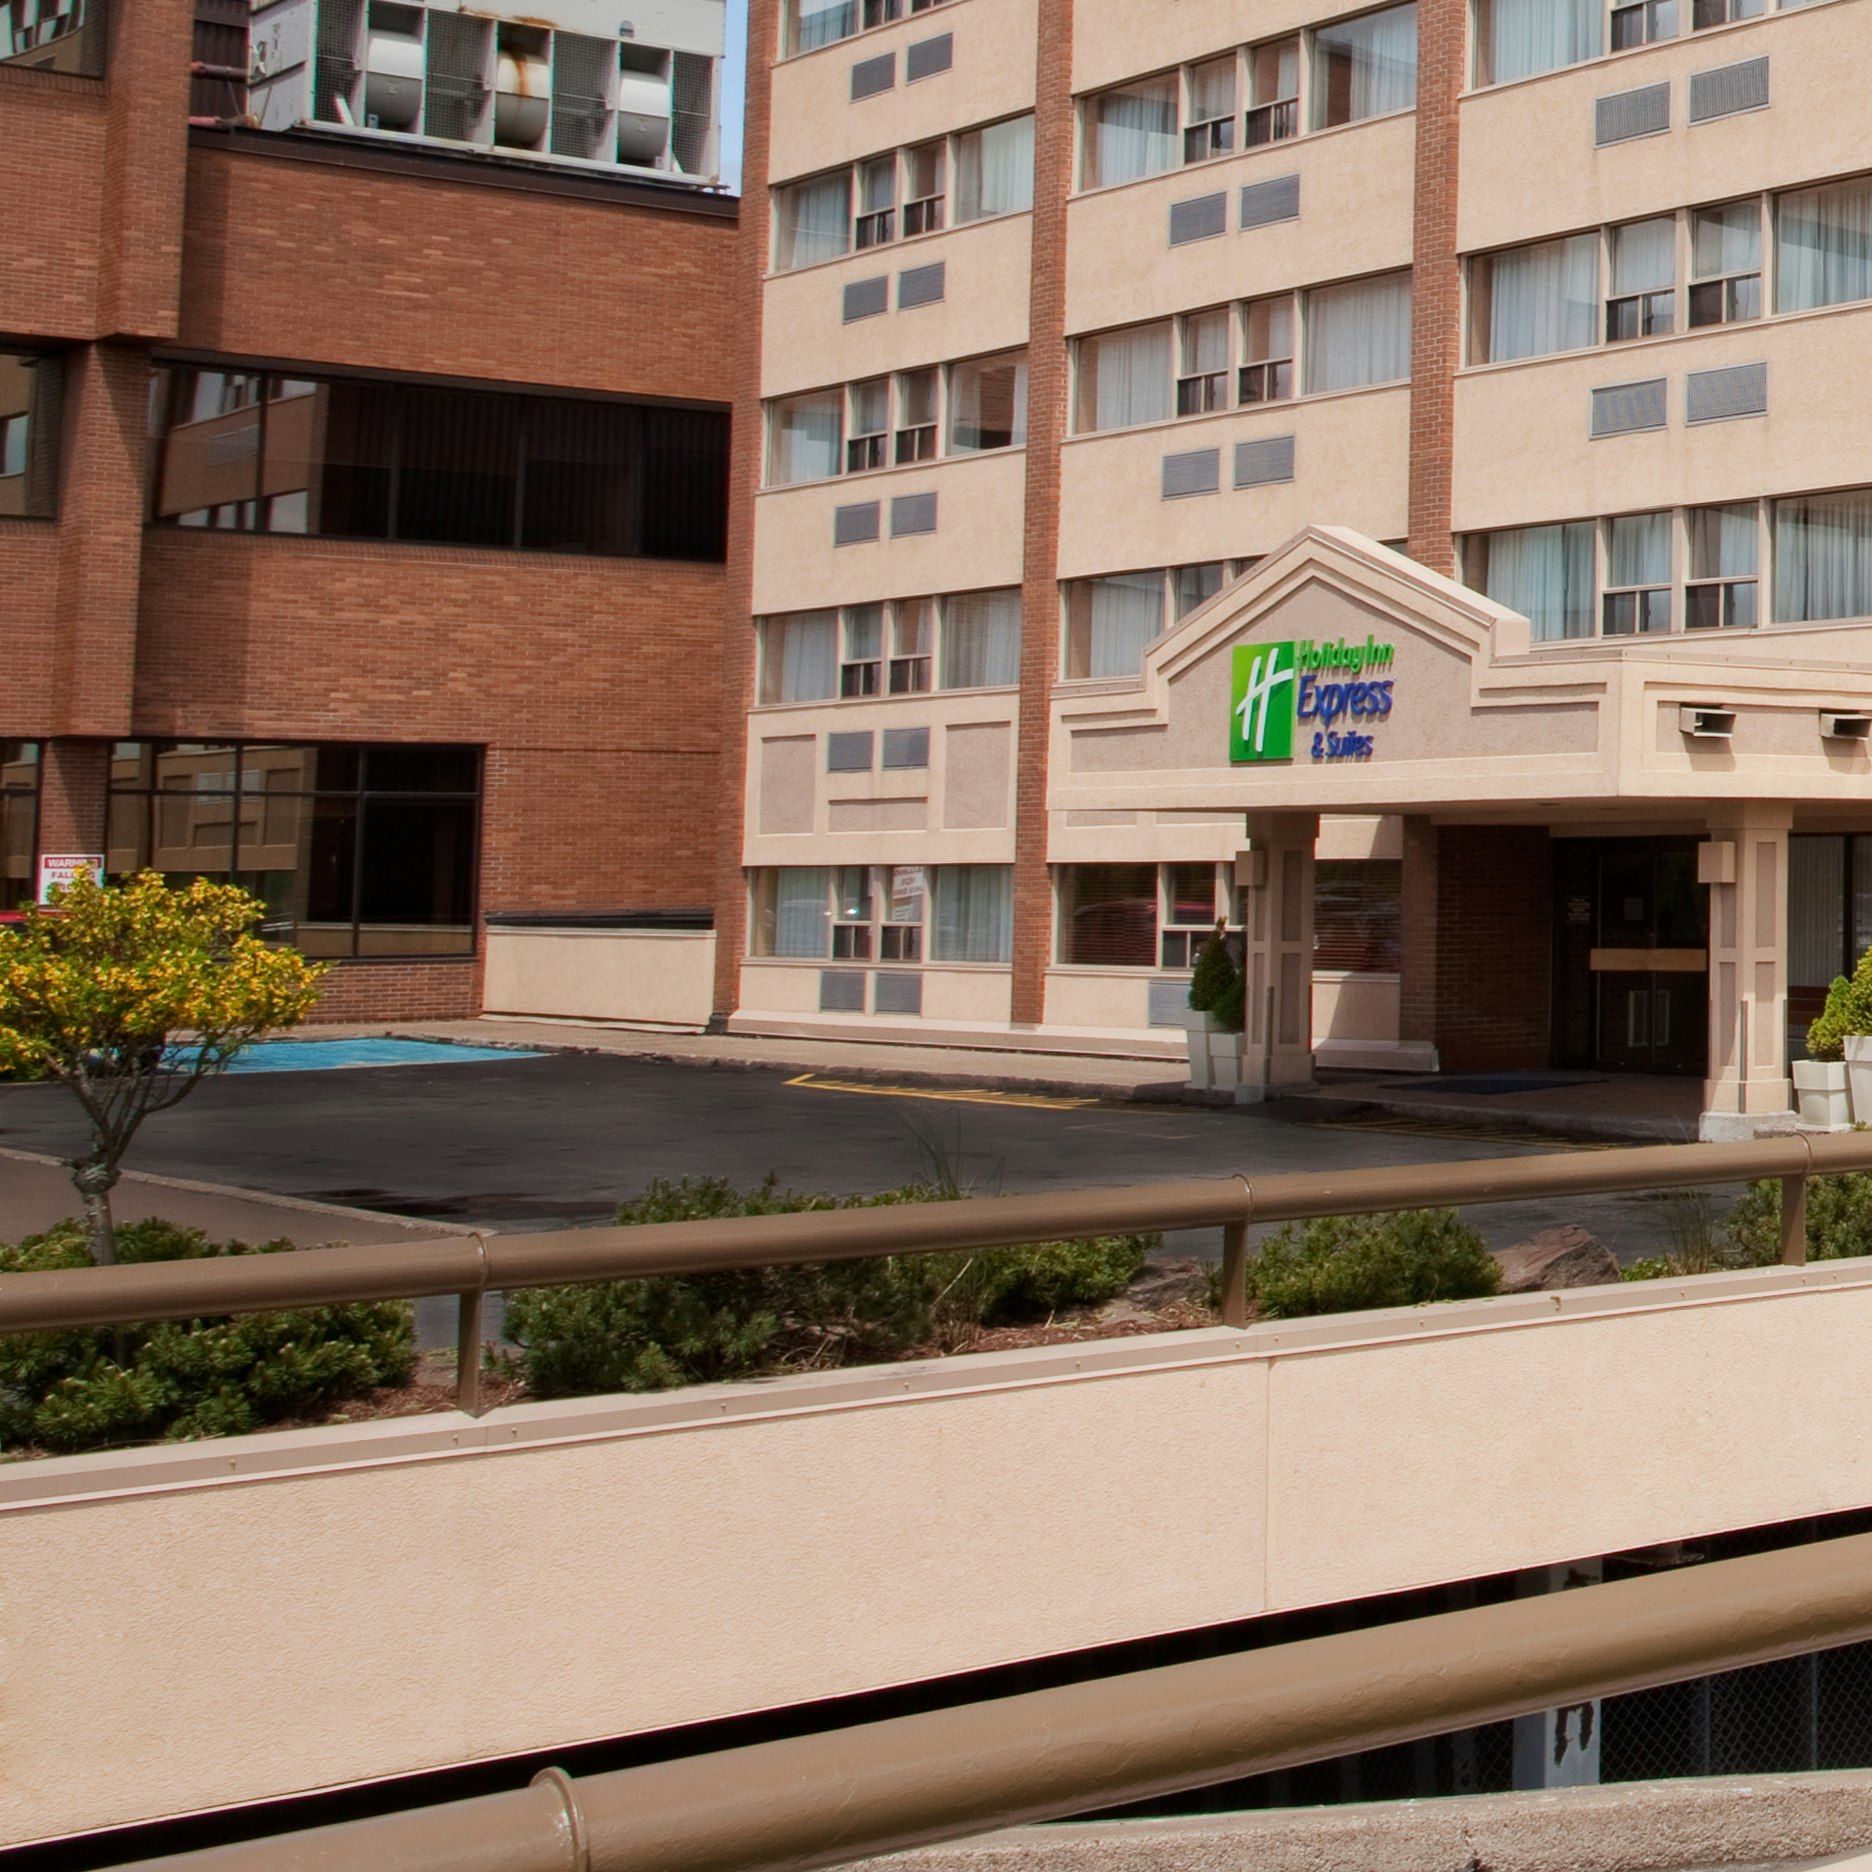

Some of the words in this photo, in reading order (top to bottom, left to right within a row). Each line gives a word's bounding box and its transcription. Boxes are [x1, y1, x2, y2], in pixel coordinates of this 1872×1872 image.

[1297, 637, 1366, 673] Holiday
[1366, 634, 1394, 665] Inn
[1297, 674, 1394, 729] Express
[1312, 731, 1324, 758] &
[1325, 730, 1374, 757] Suites
